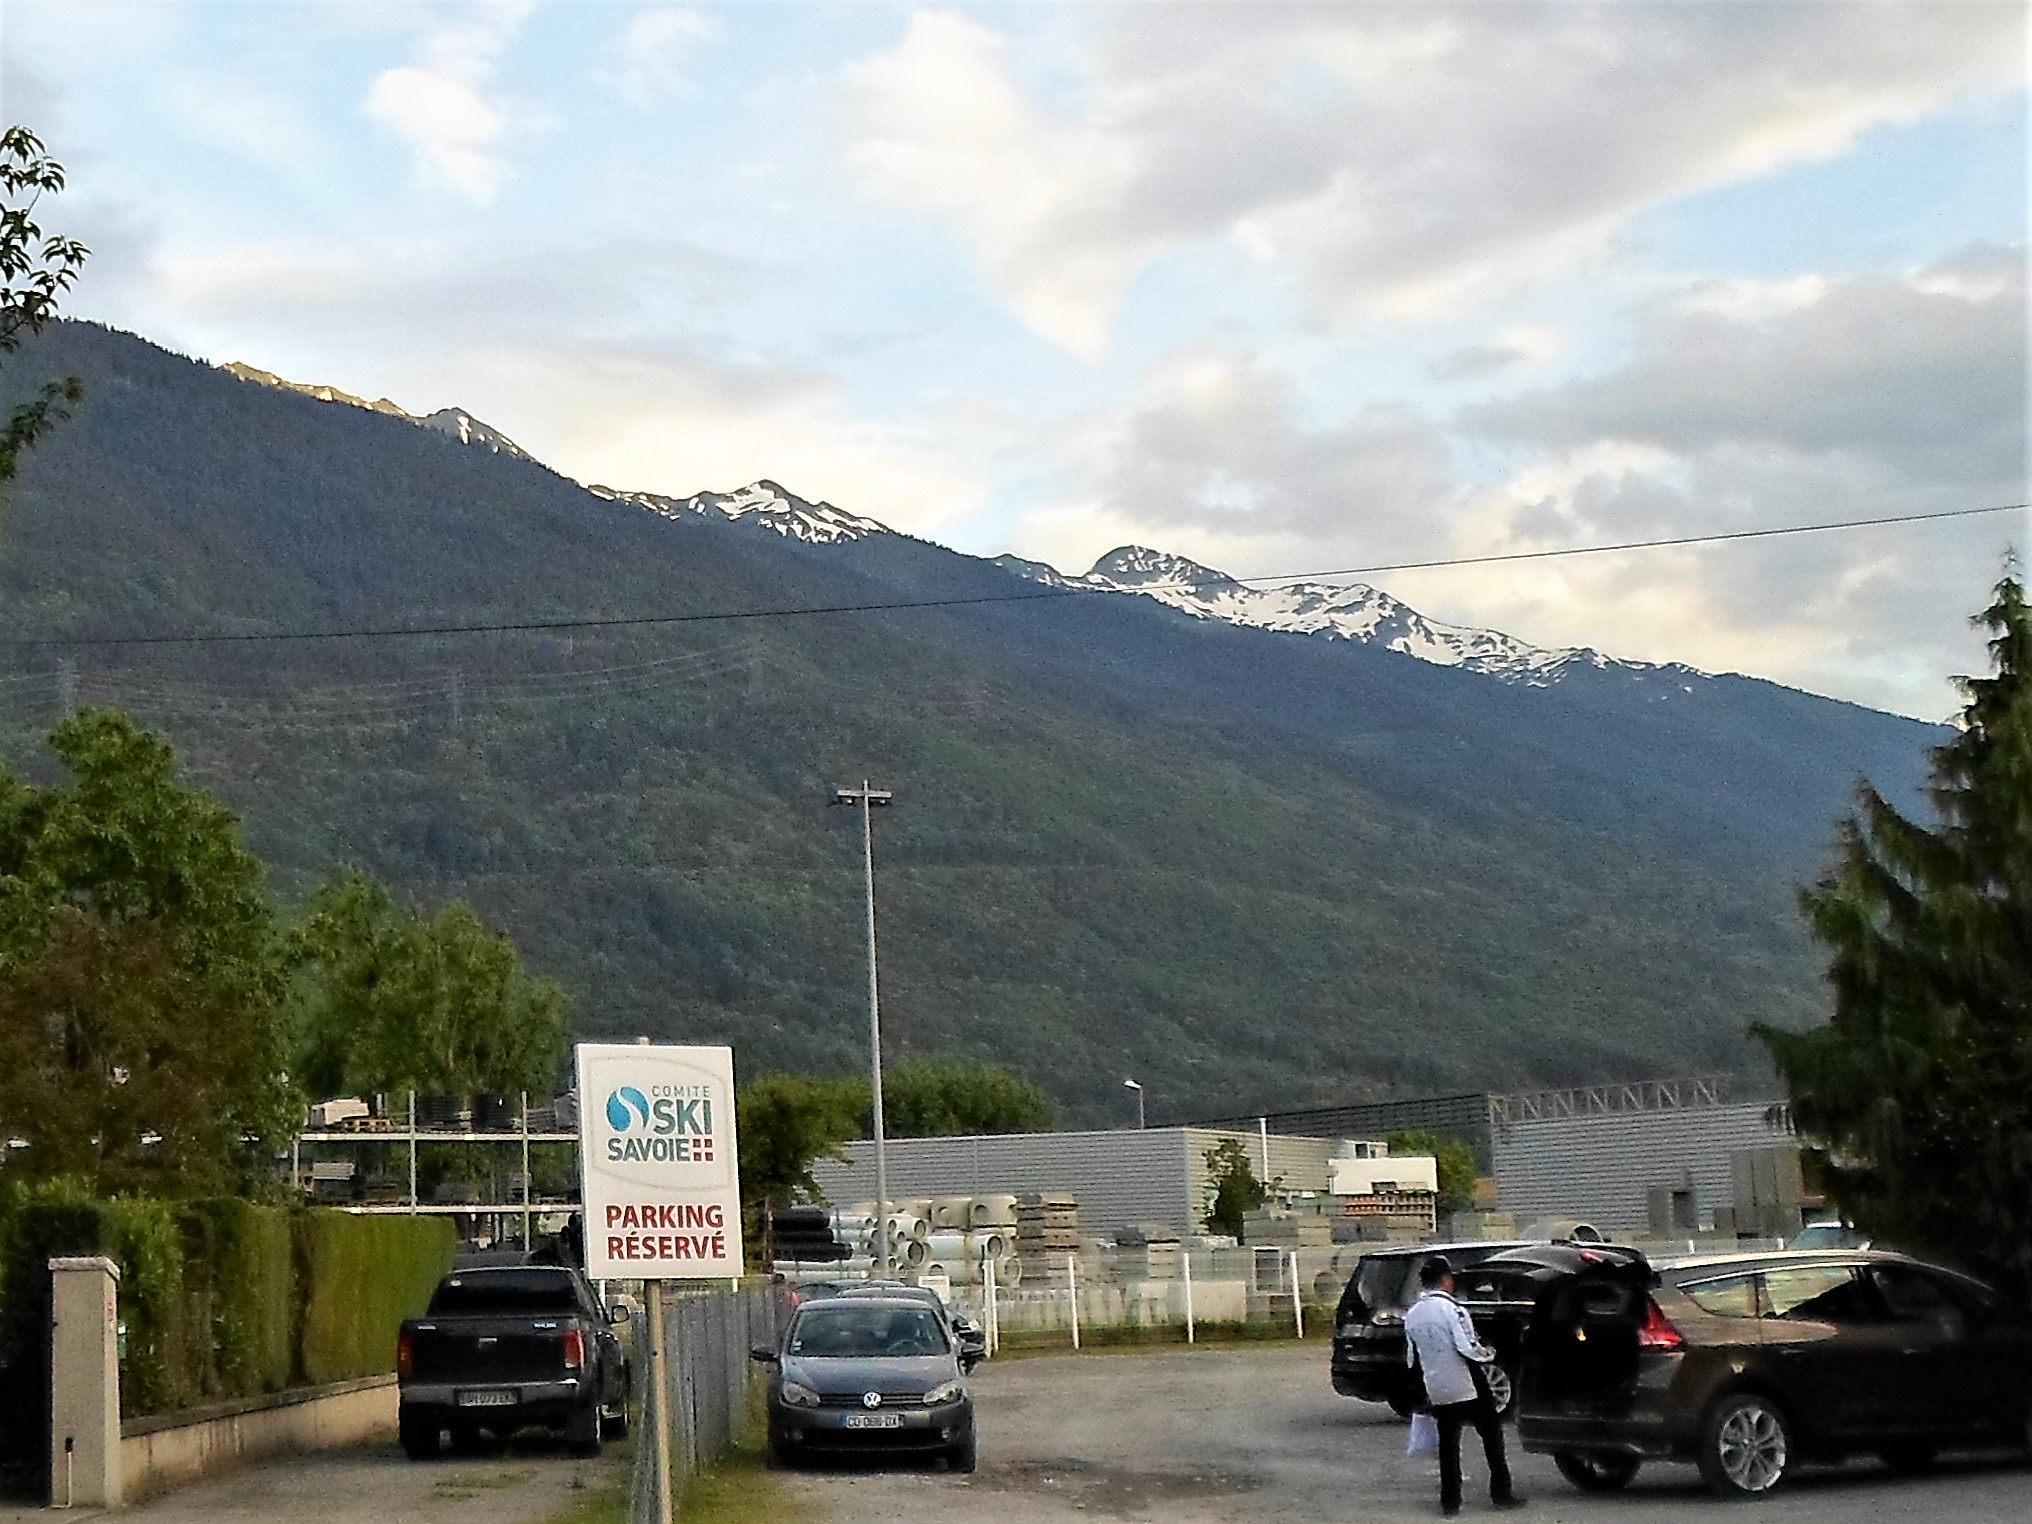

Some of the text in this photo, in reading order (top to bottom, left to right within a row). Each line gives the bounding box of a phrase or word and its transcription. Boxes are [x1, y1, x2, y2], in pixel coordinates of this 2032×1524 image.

[652, 1086, 710, 1097] COMITE
[653, 1099, 713, 1135] SKI
[608, 1138, 691, 1162] SAVOIE
[606, 1205, 724, 1228] PARKING
[608, 1231, 726, 1260] RÉSERVÉ
